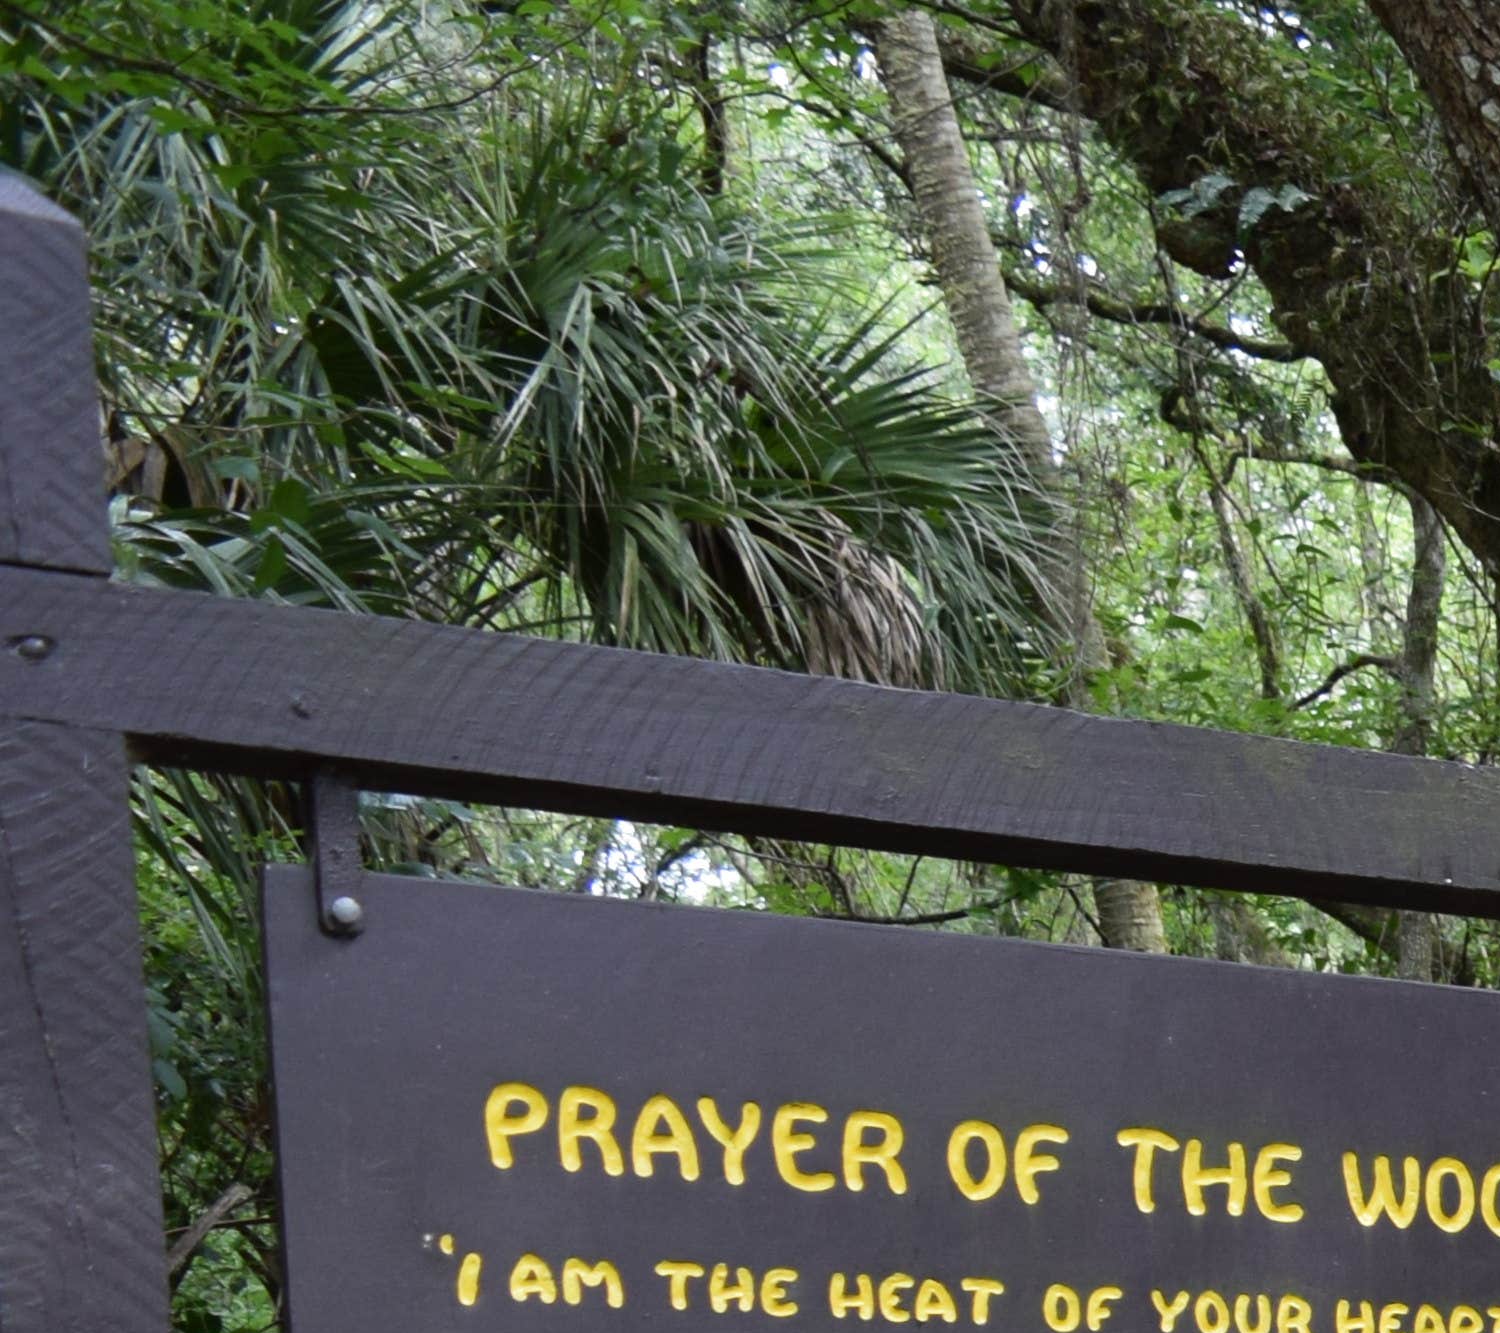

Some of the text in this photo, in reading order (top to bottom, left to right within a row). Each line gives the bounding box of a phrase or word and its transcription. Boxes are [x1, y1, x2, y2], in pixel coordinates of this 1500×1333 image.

[483, 1082, 909, 1193] PRAYER
[946, 1120, 1071, 1204] OF
[1116, 1127, 1306, 1220] THE
[509, 1253, 627, 1305] AM
[655, 1260, 800, 1318] THE
[828, 1272, 1007, 1322] HEAT
[1041, 1283, 1124, 1333] OF
